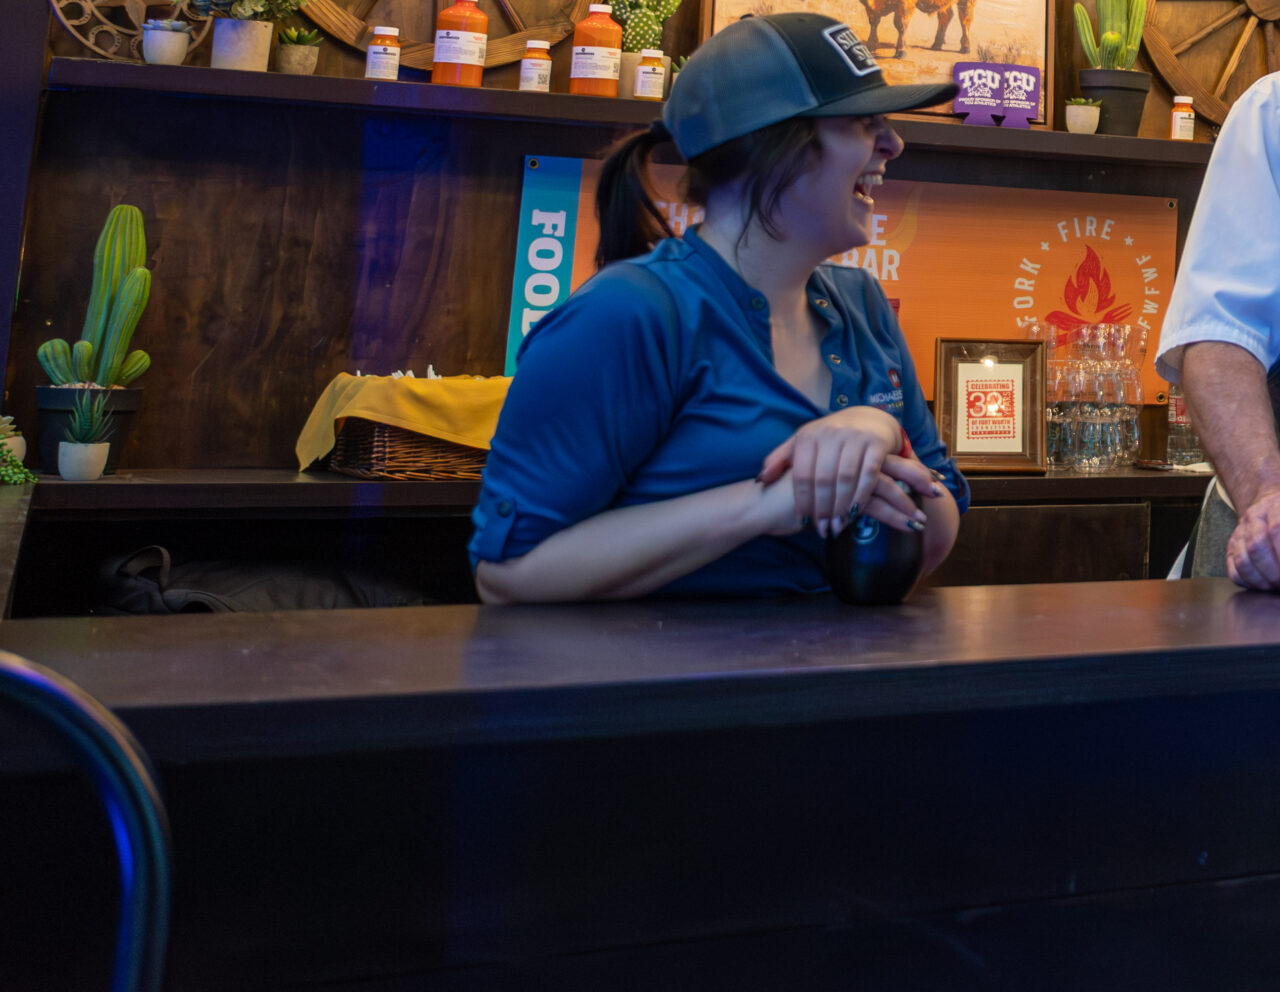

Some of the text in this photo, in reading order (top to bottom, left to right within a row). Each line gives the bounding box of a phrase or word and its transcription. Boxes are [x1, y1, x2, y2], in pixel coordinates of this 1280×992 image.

[959, 69, 1001, 89] TCU
[1057, 216, 1115, 243] FIRE
[1013, 258, 1041, 329] FORK
[969, 392, 1002, 417] 32
